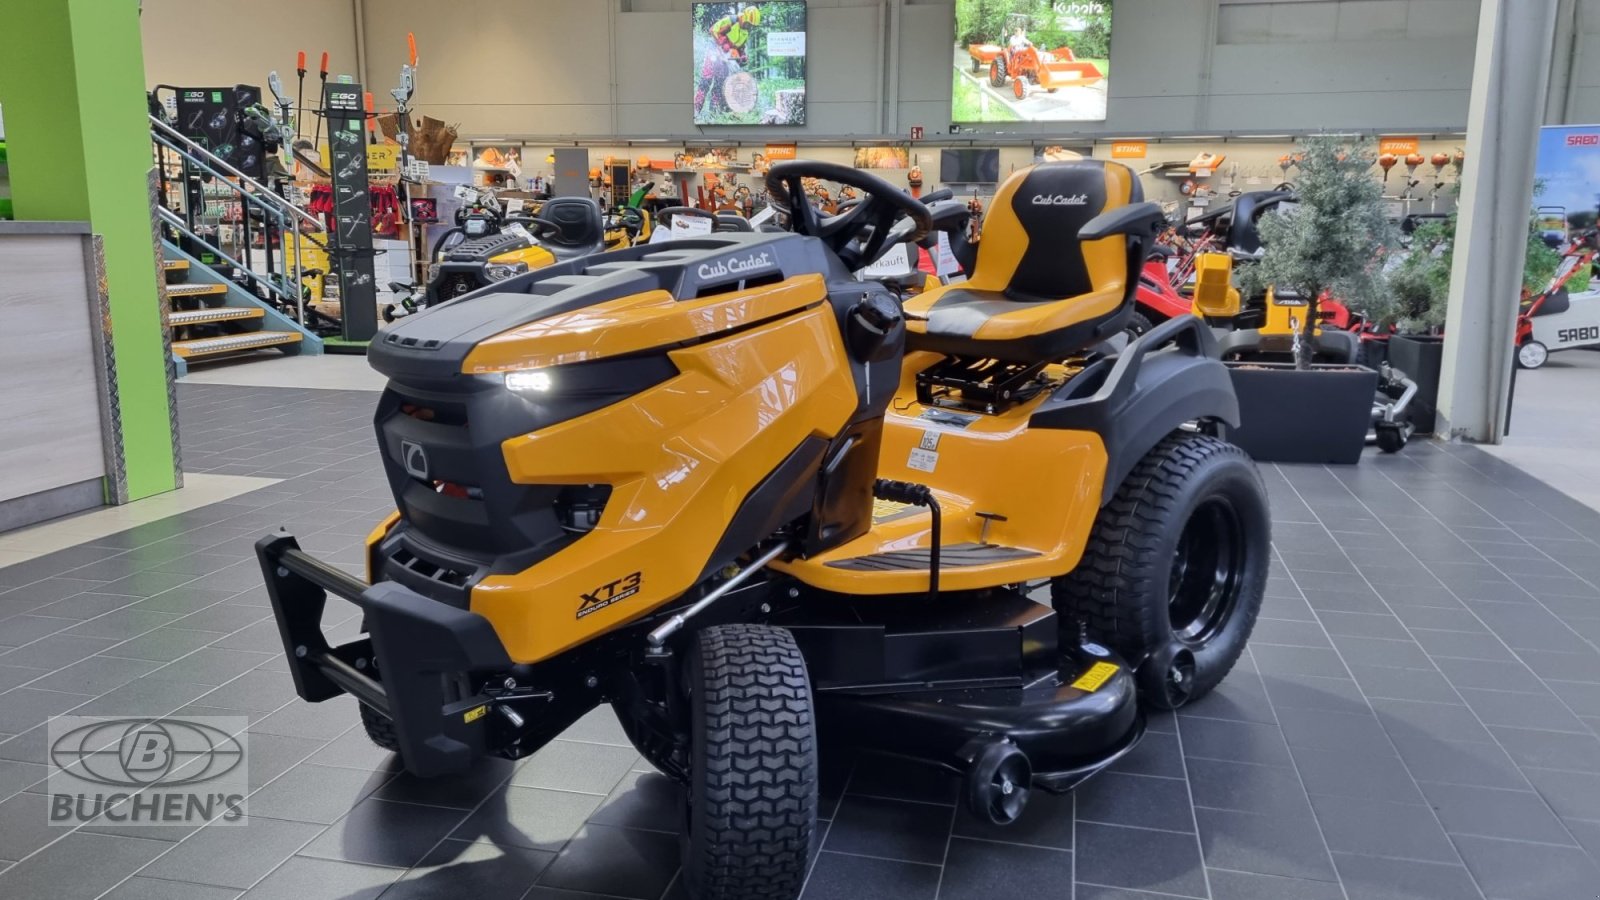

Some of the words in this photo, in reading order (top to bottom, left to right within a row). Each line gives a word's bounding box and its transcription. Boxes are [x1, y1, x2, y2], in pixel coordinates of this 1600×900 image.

[1053, 2, 1104, 14] Kubota
[331, 92, 357, 100] EGO
[1385, 142, 1413, 150] STIHL
[1567, 135, 1598, 146] SABO
[768, 147, 792, 155] STIHL
[1115, 145, 1142, 153] STIHL
[1031, 194, 1053, 205] Cub
[1053, 193, 1088, 205] Cadet
[697, 261, 728, 280] Cub
[727, 251, 772, 273] Cadet
[1558, 326, 1599, 343] SABO
[577, 571, 642, 611] XT3
[577, 600, 609, 617] ENDURO
[610, 588, 637, 603] SERIES
